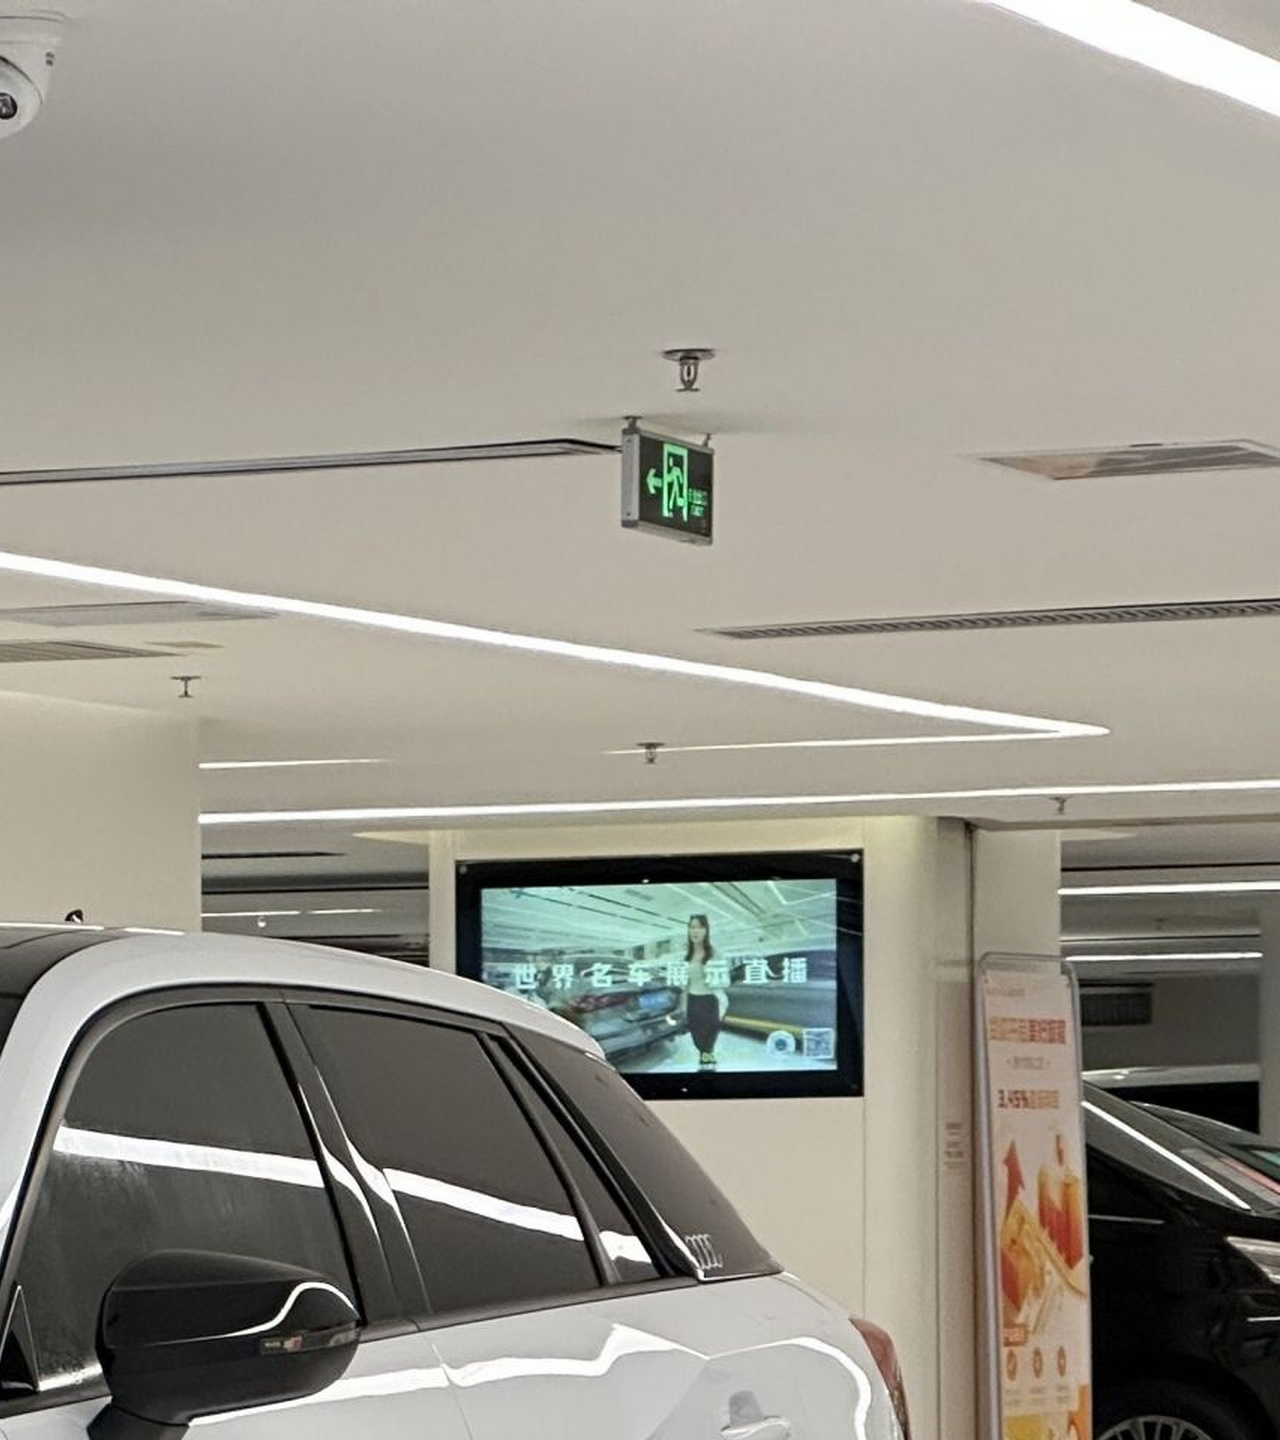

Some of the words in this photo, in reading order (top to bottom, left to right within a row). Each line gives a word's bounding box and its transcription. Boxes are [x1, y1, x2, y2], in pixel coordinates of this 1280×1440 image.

[512, 957, 808, 990] 世界名车展示直播
